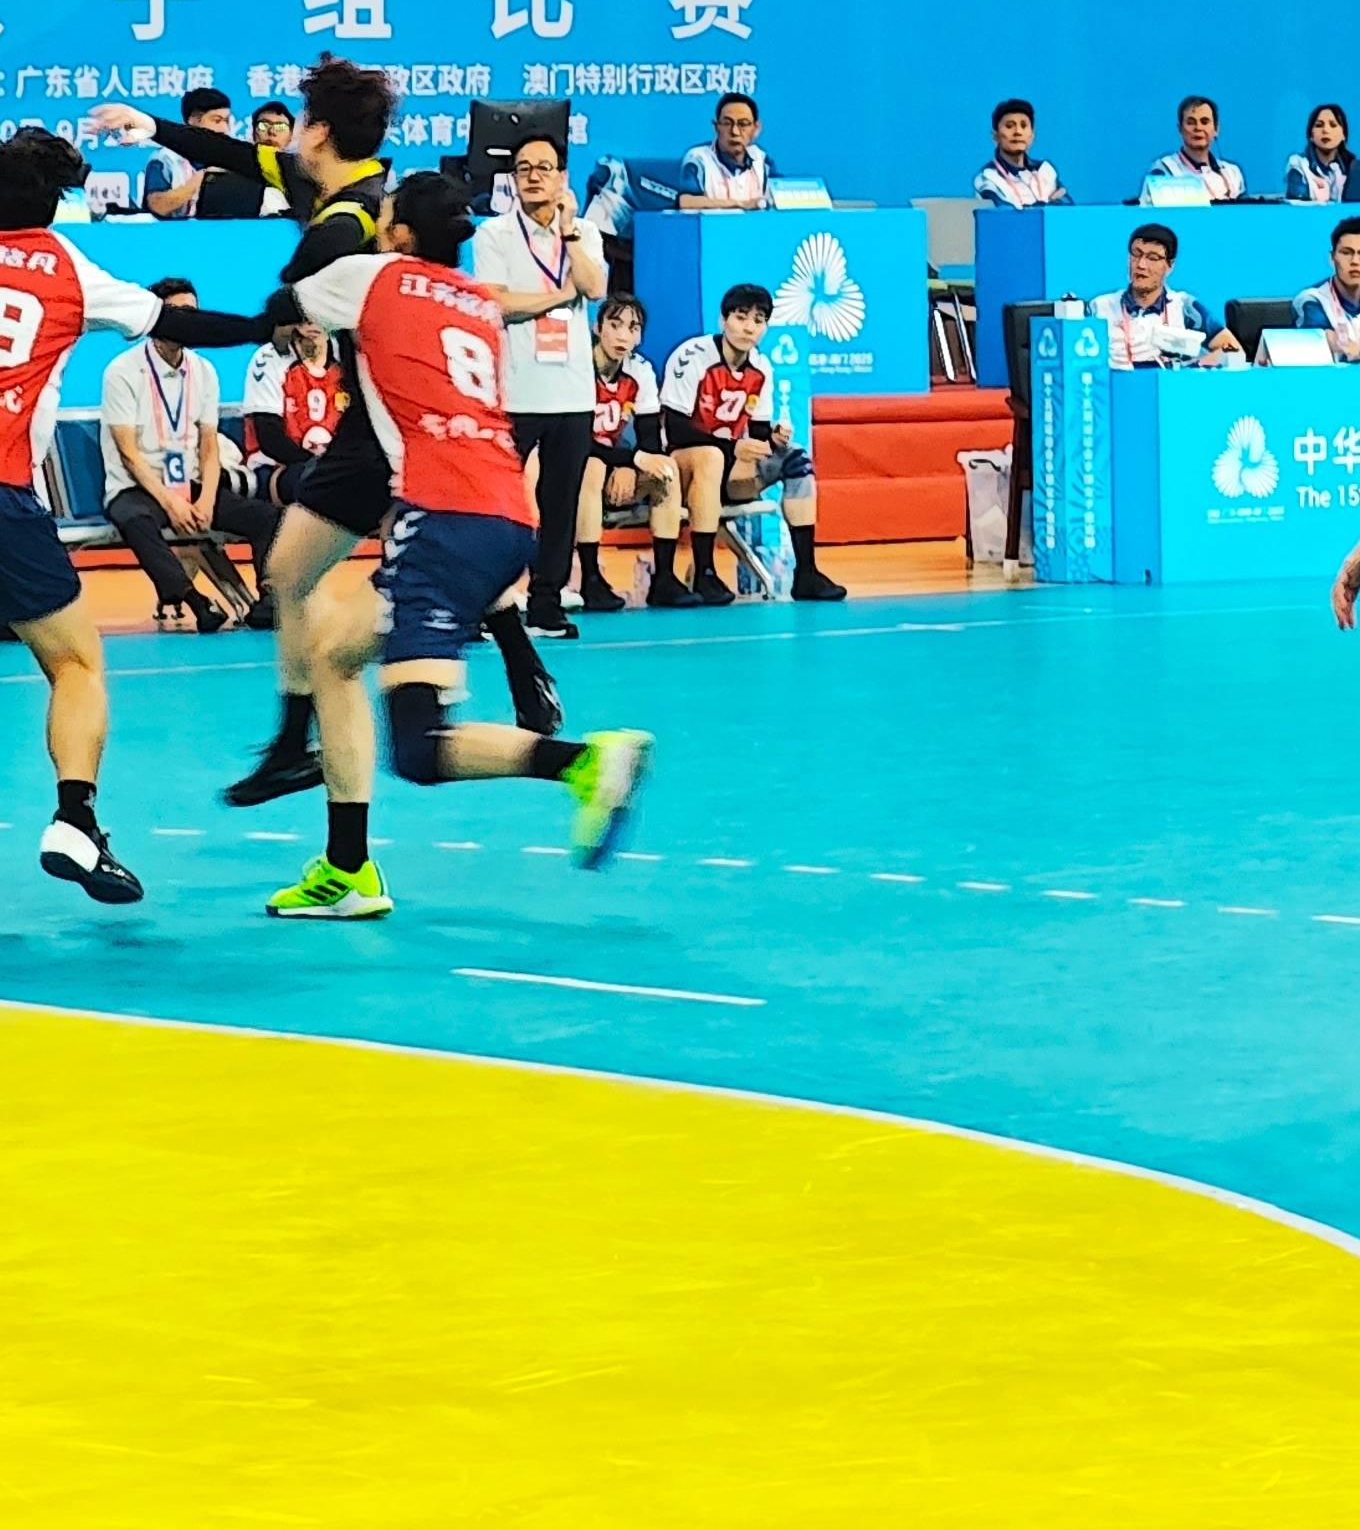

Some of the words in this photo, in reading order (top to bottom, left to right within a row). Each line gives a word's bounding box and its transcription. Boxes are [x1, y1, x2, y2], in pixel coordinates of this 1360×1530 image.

[522, 63, 757, 96] 澳门特别行政区政府
[440, 326, 499, 409] 8
[1296, 485, 1330, 509] The
